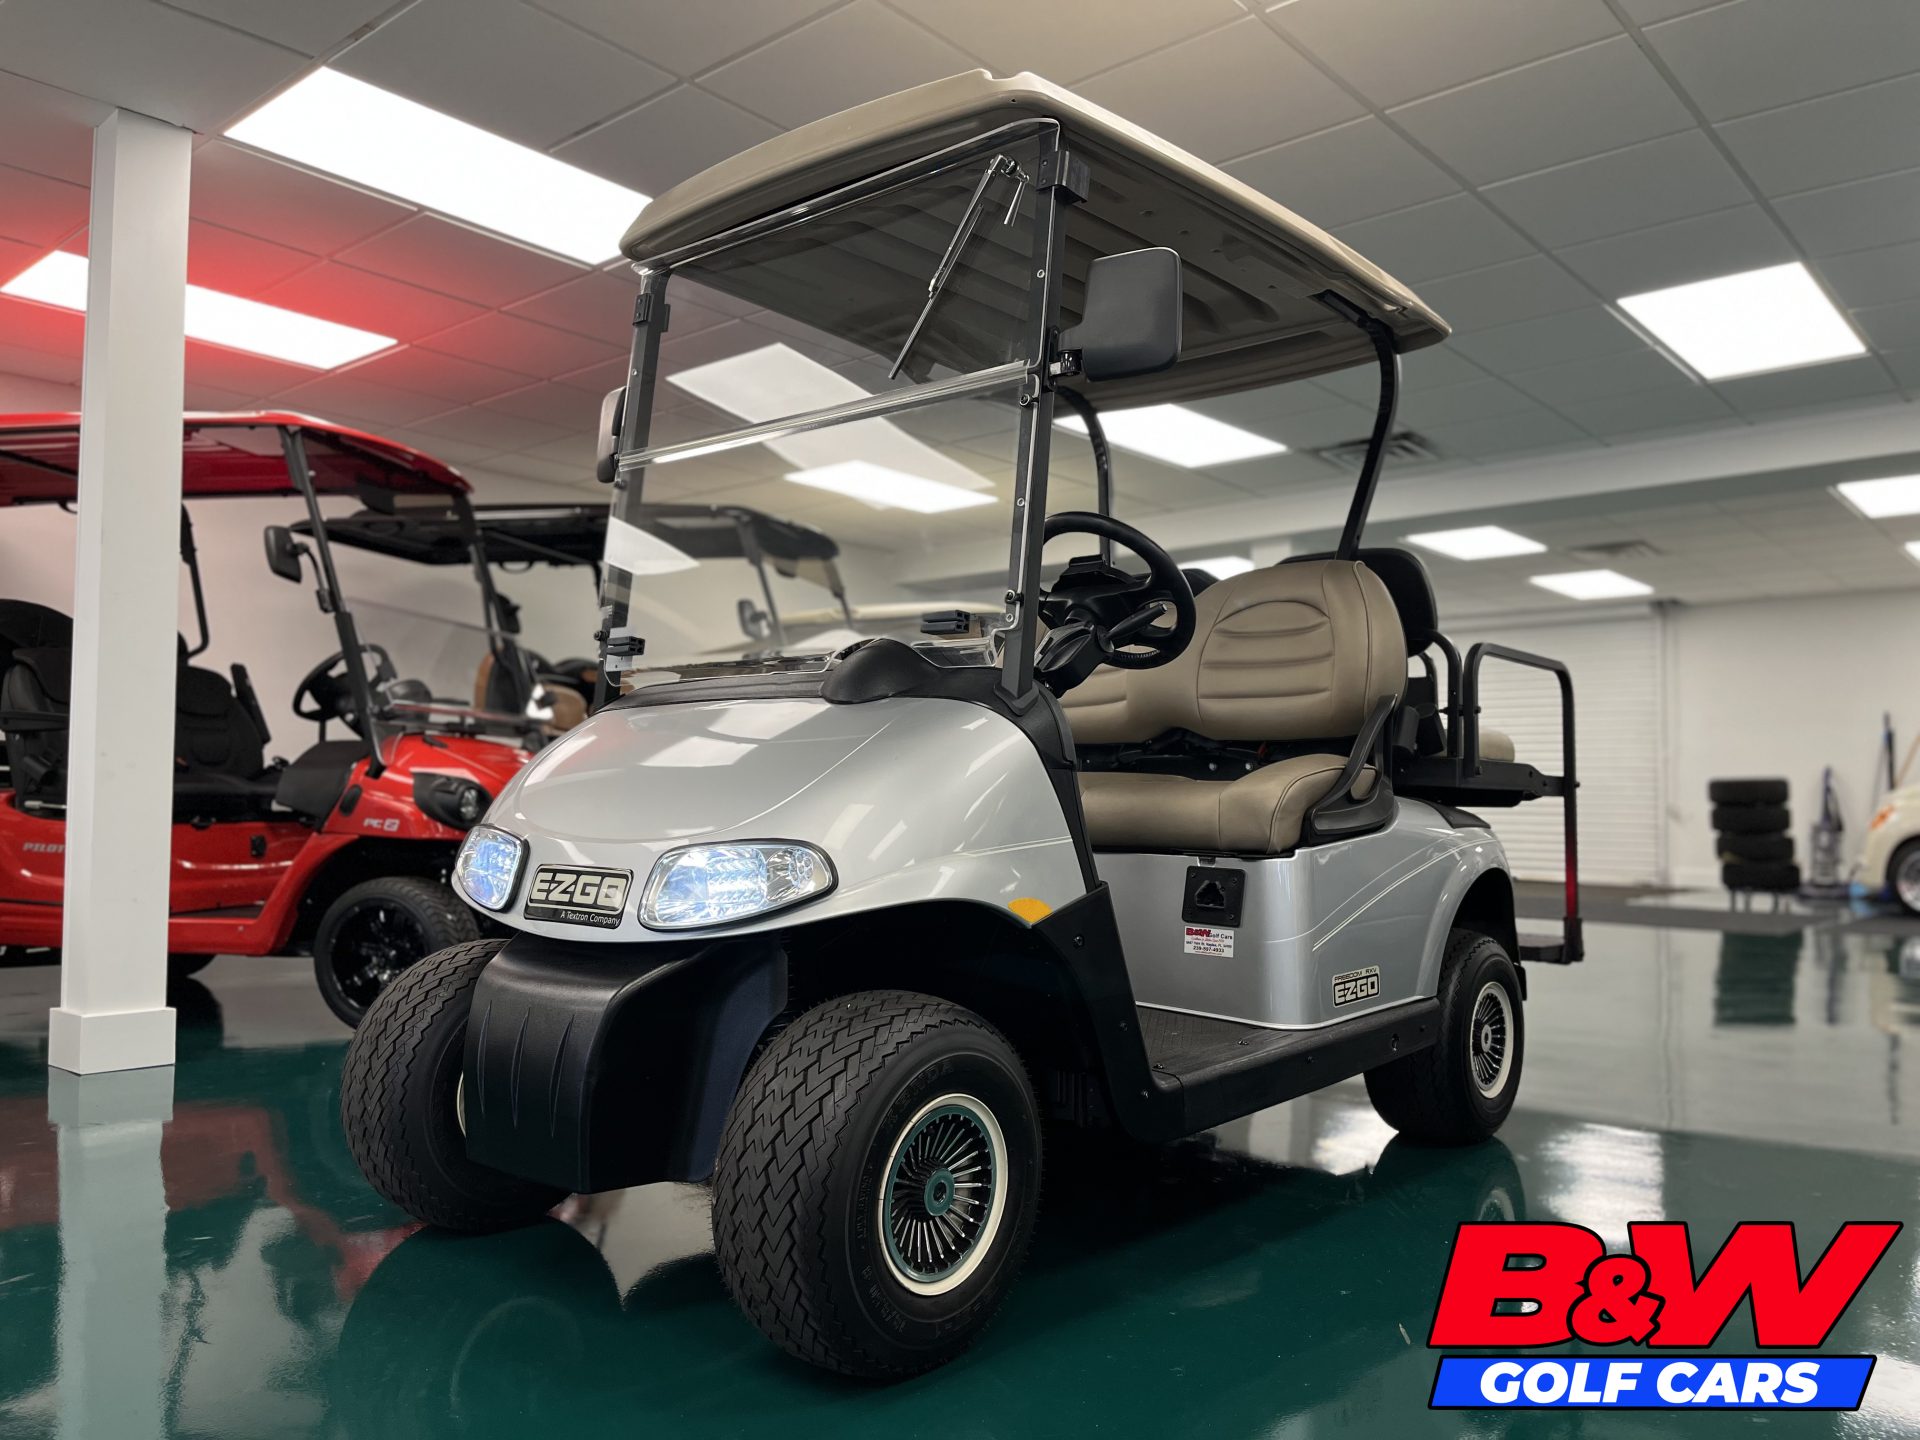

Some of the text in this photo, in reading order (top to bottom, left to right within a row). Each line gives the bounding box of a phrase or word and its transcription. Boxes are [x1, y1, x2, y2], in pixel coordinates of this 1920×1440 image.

[567, 911, 589, 921] Textron
[589, 914, 620, 926] Company
[1334, 972, 1362, 982] FREEDOM
